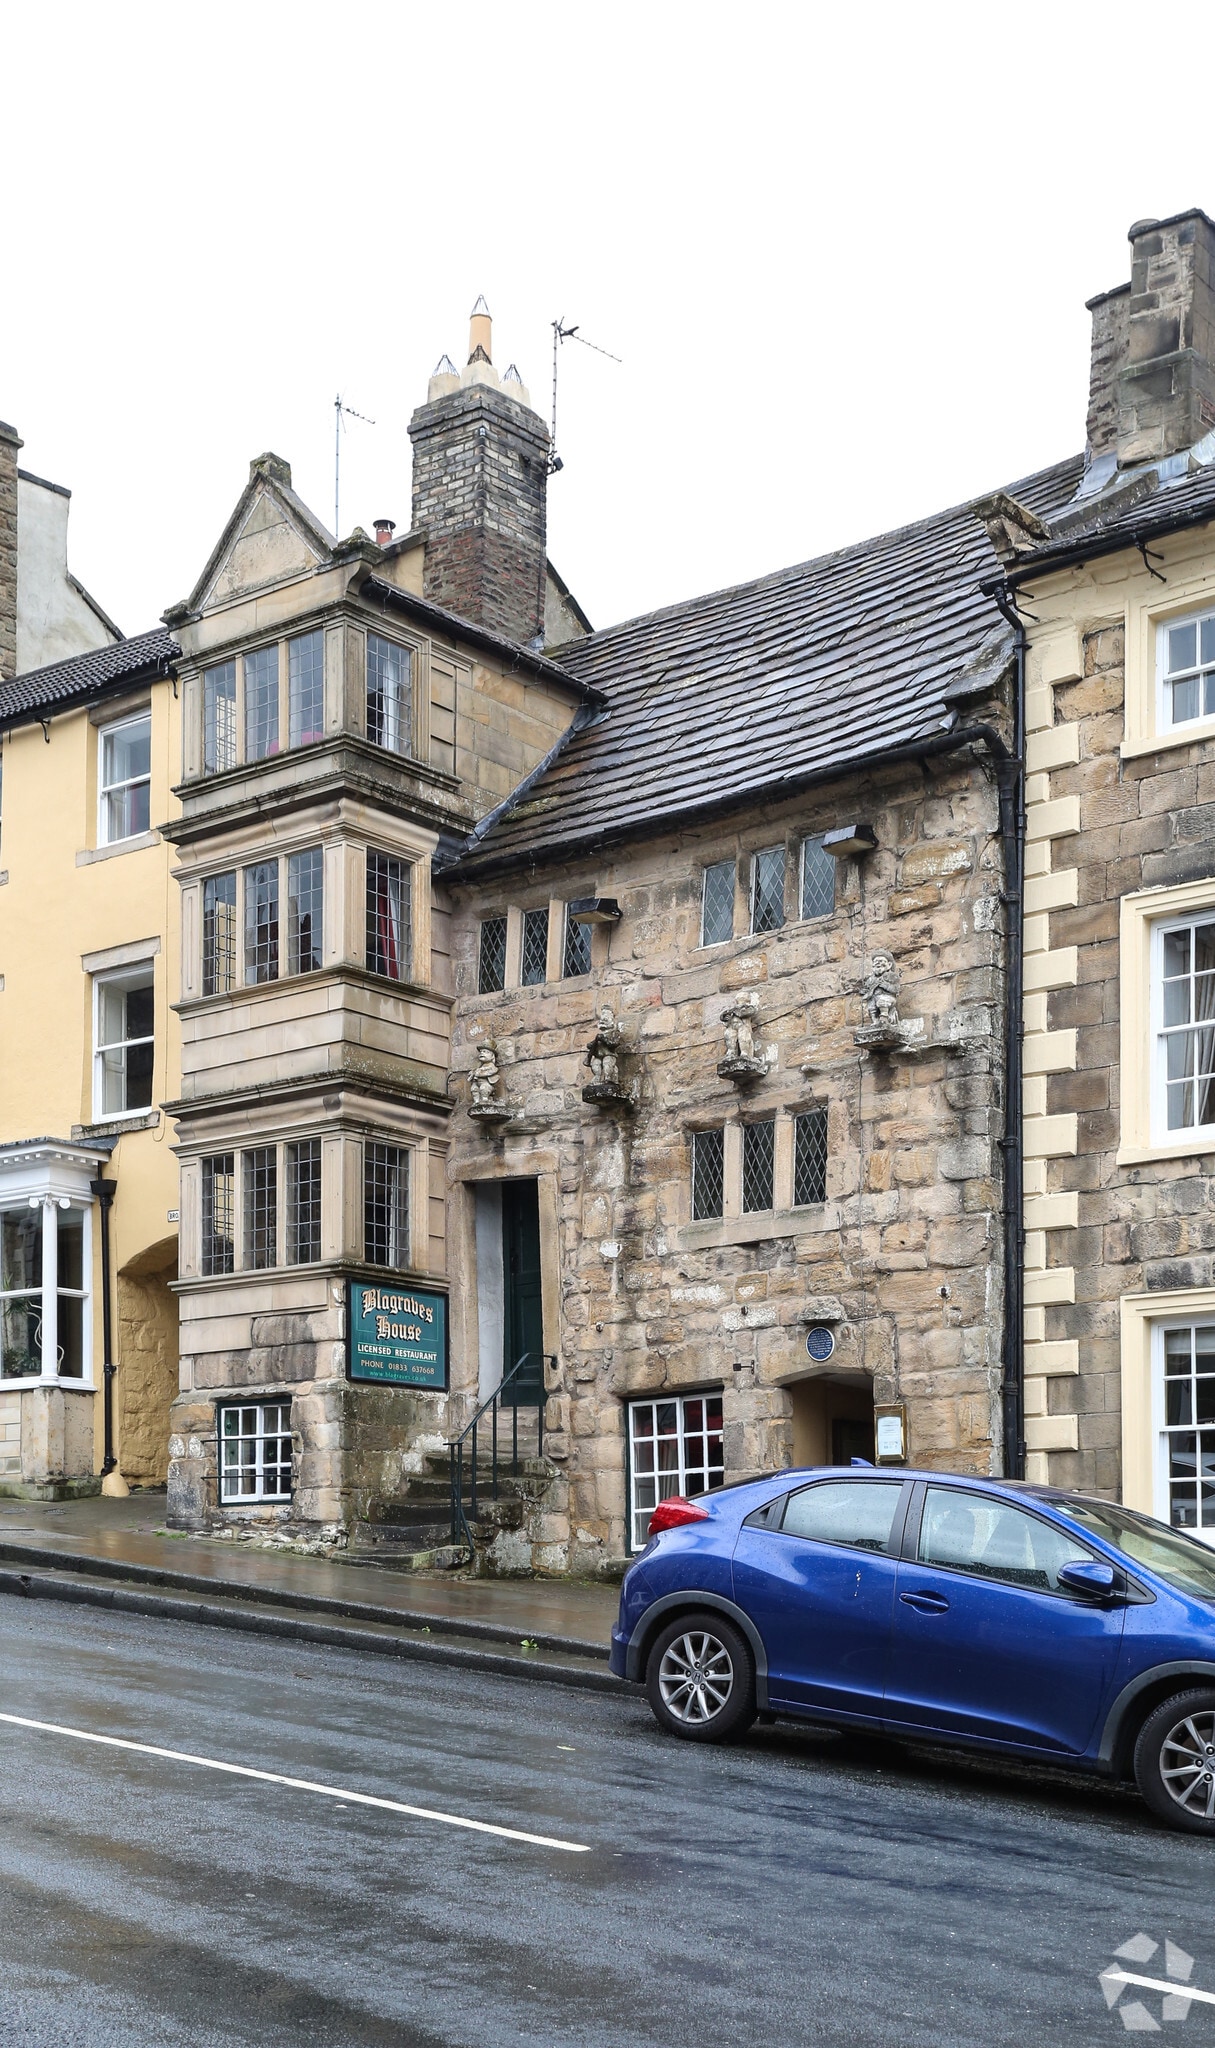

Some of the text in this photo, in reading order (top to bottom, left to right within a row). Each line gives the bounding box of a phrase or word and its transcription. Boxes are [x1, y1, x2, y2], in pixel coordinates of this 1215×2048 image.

[362, 1288, 433, 1323] Blagraves
[376, 1315, 422, 1341] House
[357, 1343, 437, 1361] LICENSED RESTAURANT
[360, 1359, 435, 1375] PHONE 01833 637668
